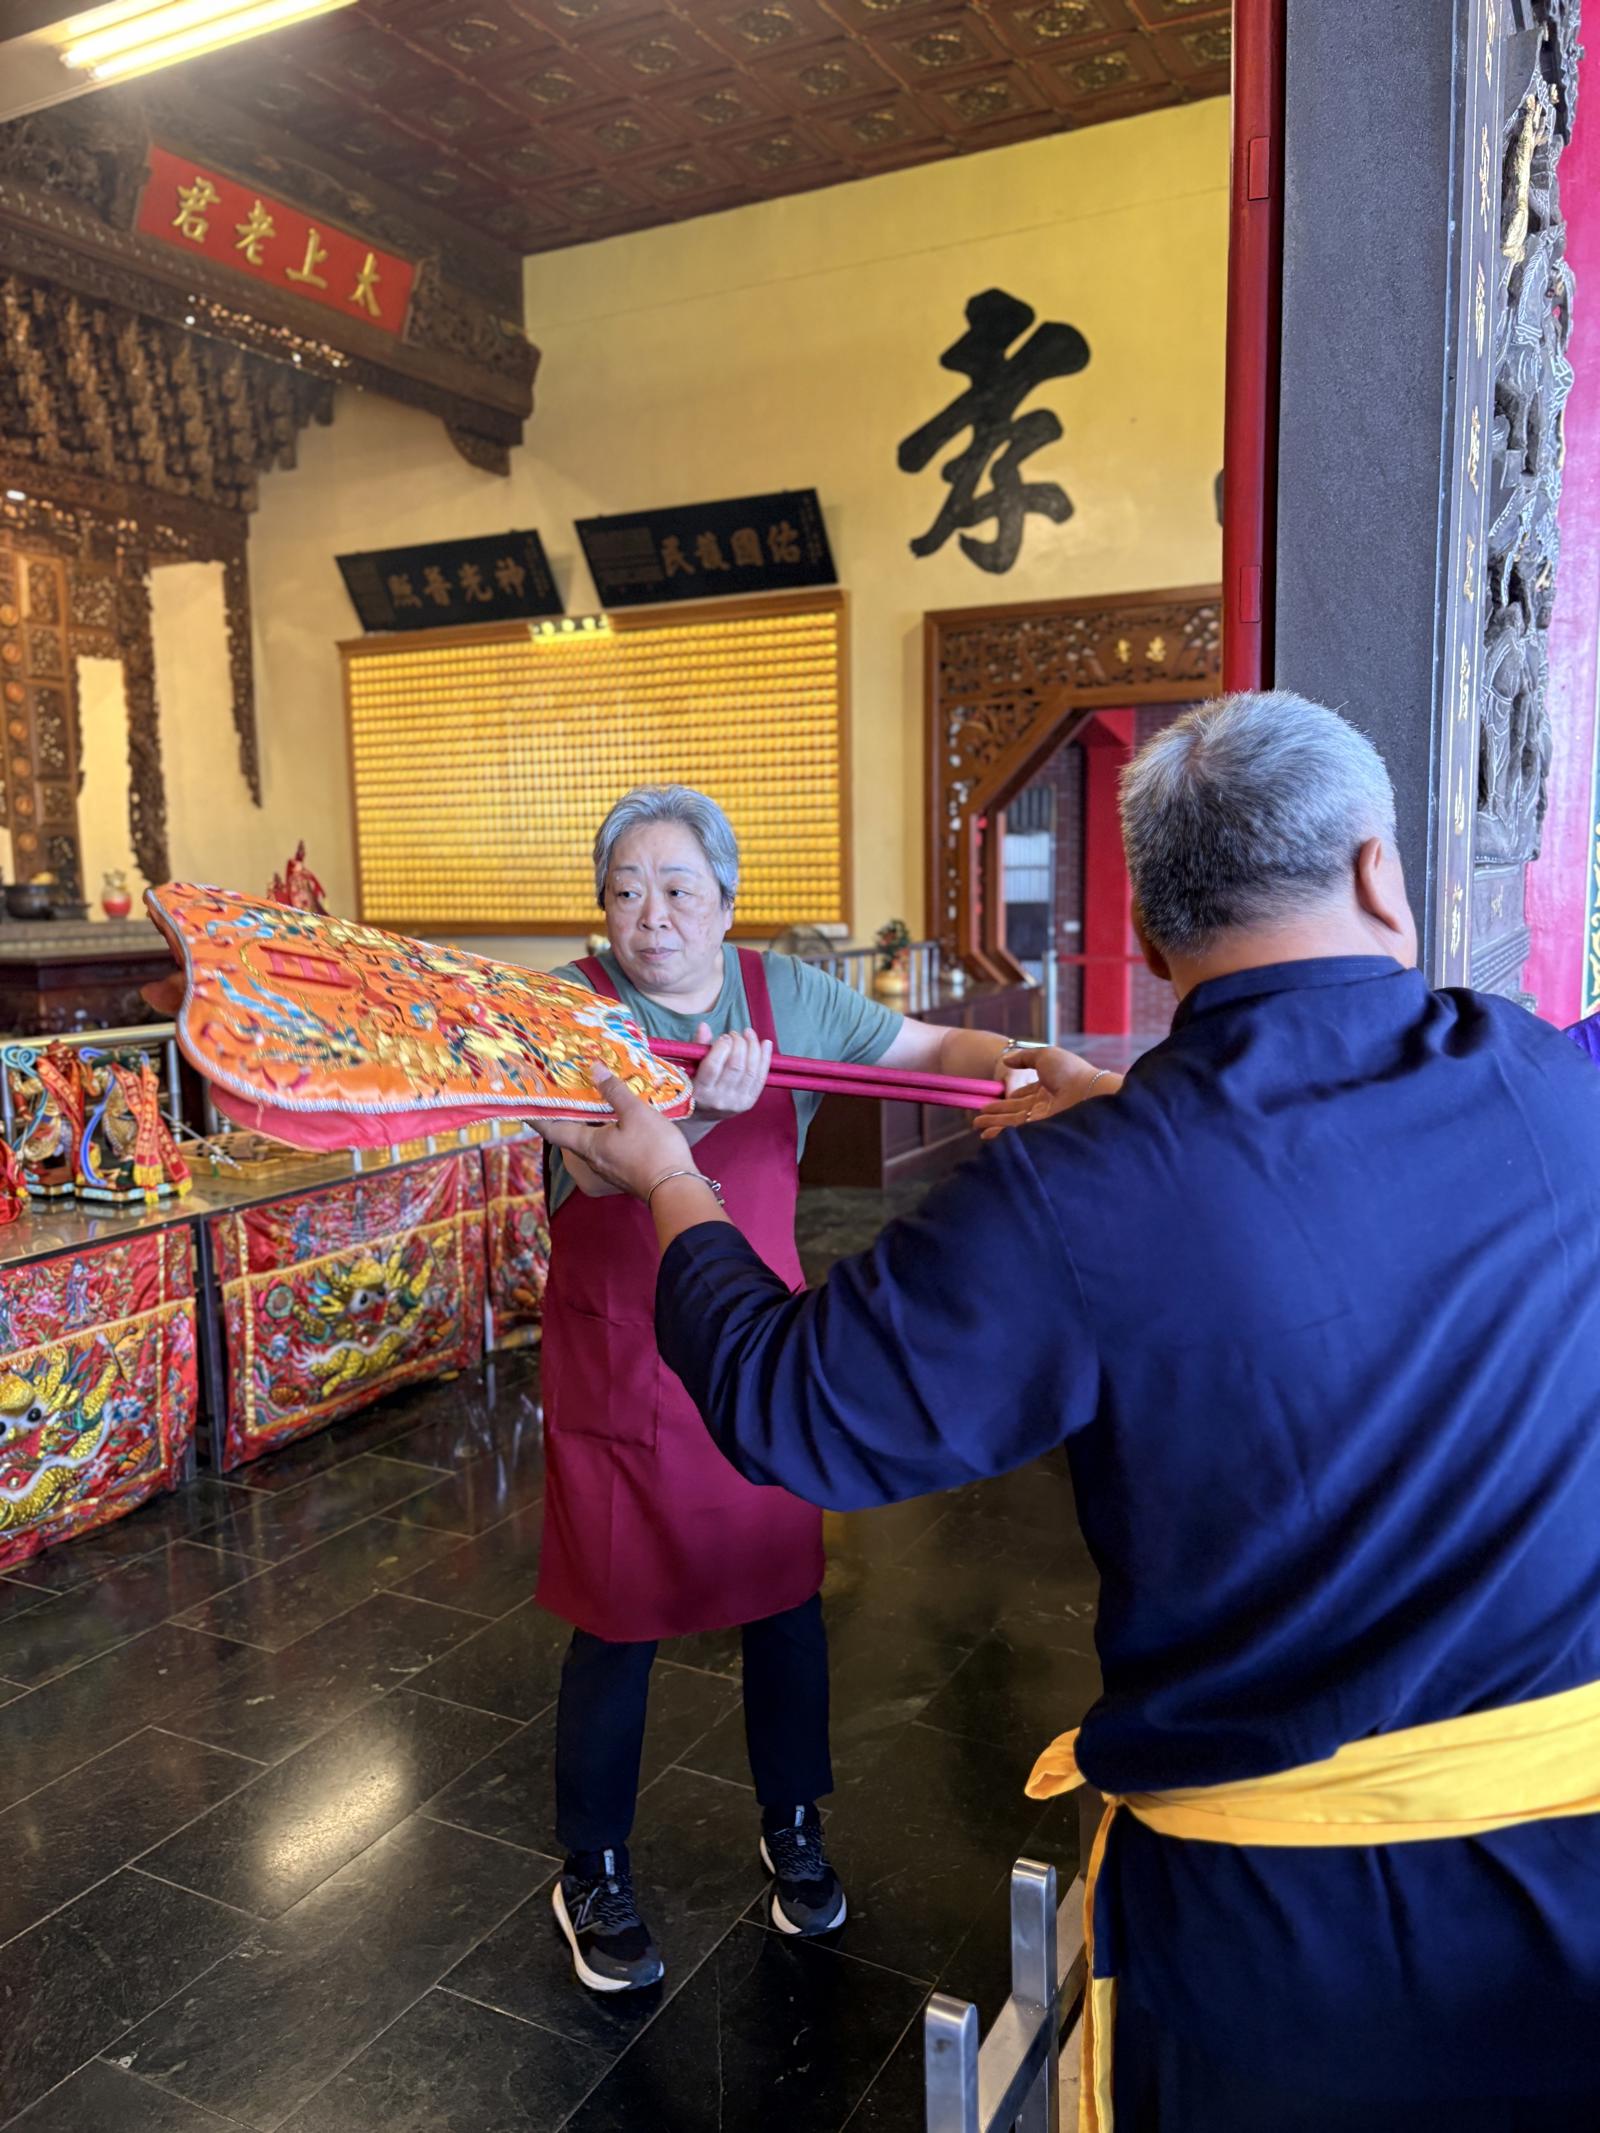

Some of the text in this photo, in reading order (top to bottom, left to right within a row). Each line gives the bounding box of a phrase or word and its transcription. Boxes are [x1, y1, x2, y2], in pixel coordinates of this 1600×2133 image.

[173, 176, 382, 317] 太上老君
[897, 287, 1091, 575] 孝
